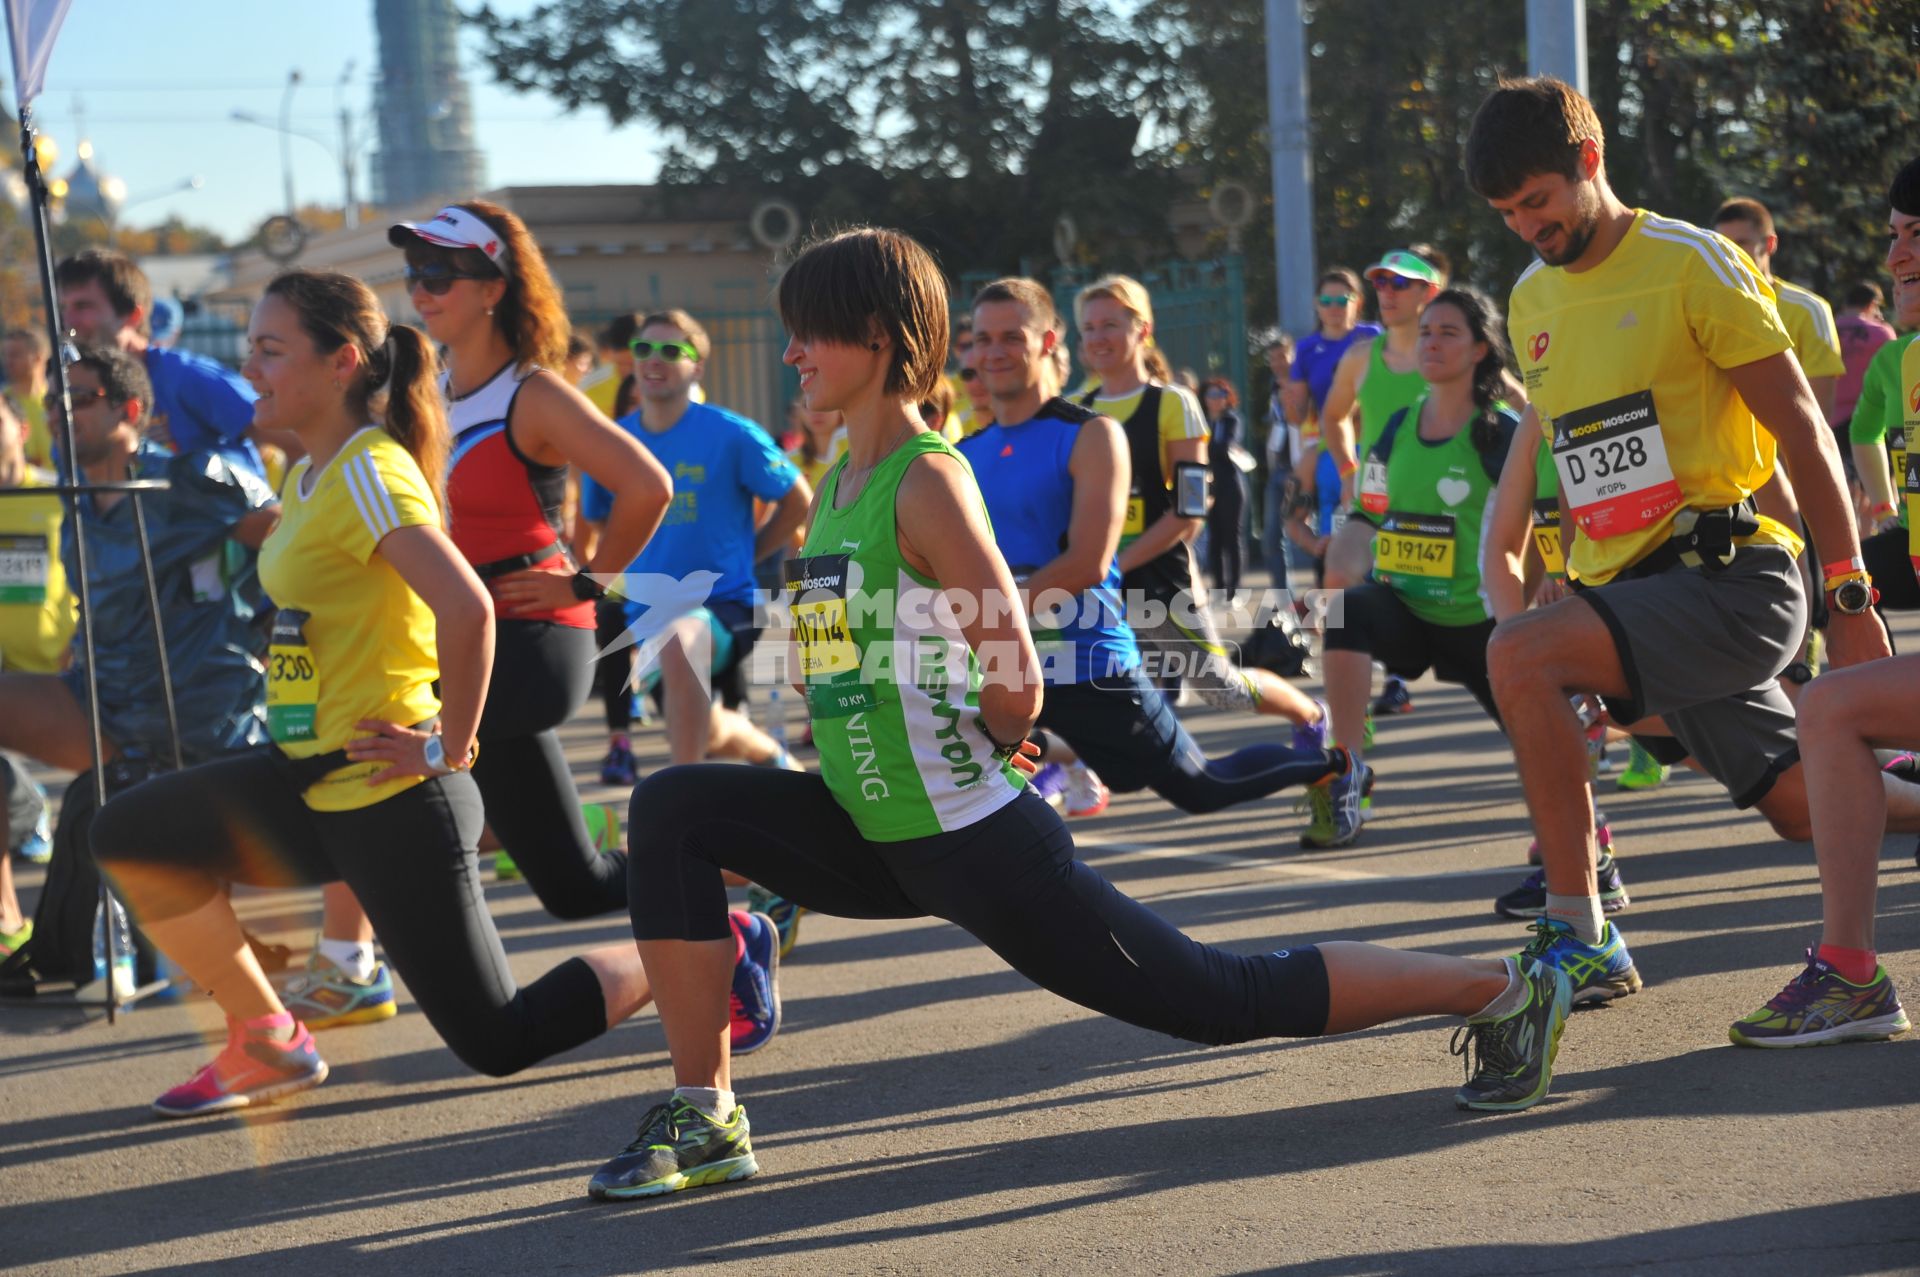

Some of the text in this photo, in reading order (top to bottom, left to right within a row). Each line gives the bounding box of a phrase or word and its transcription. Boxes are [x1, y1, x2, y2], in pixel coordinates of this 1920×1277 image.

[1566, 436, 1647, 485] D 328
[1596, 481, 1627, 497] ИГОРЬ
[1380, 538, 1448, 563] D 19147
[838, 697, 848, 708] 10
